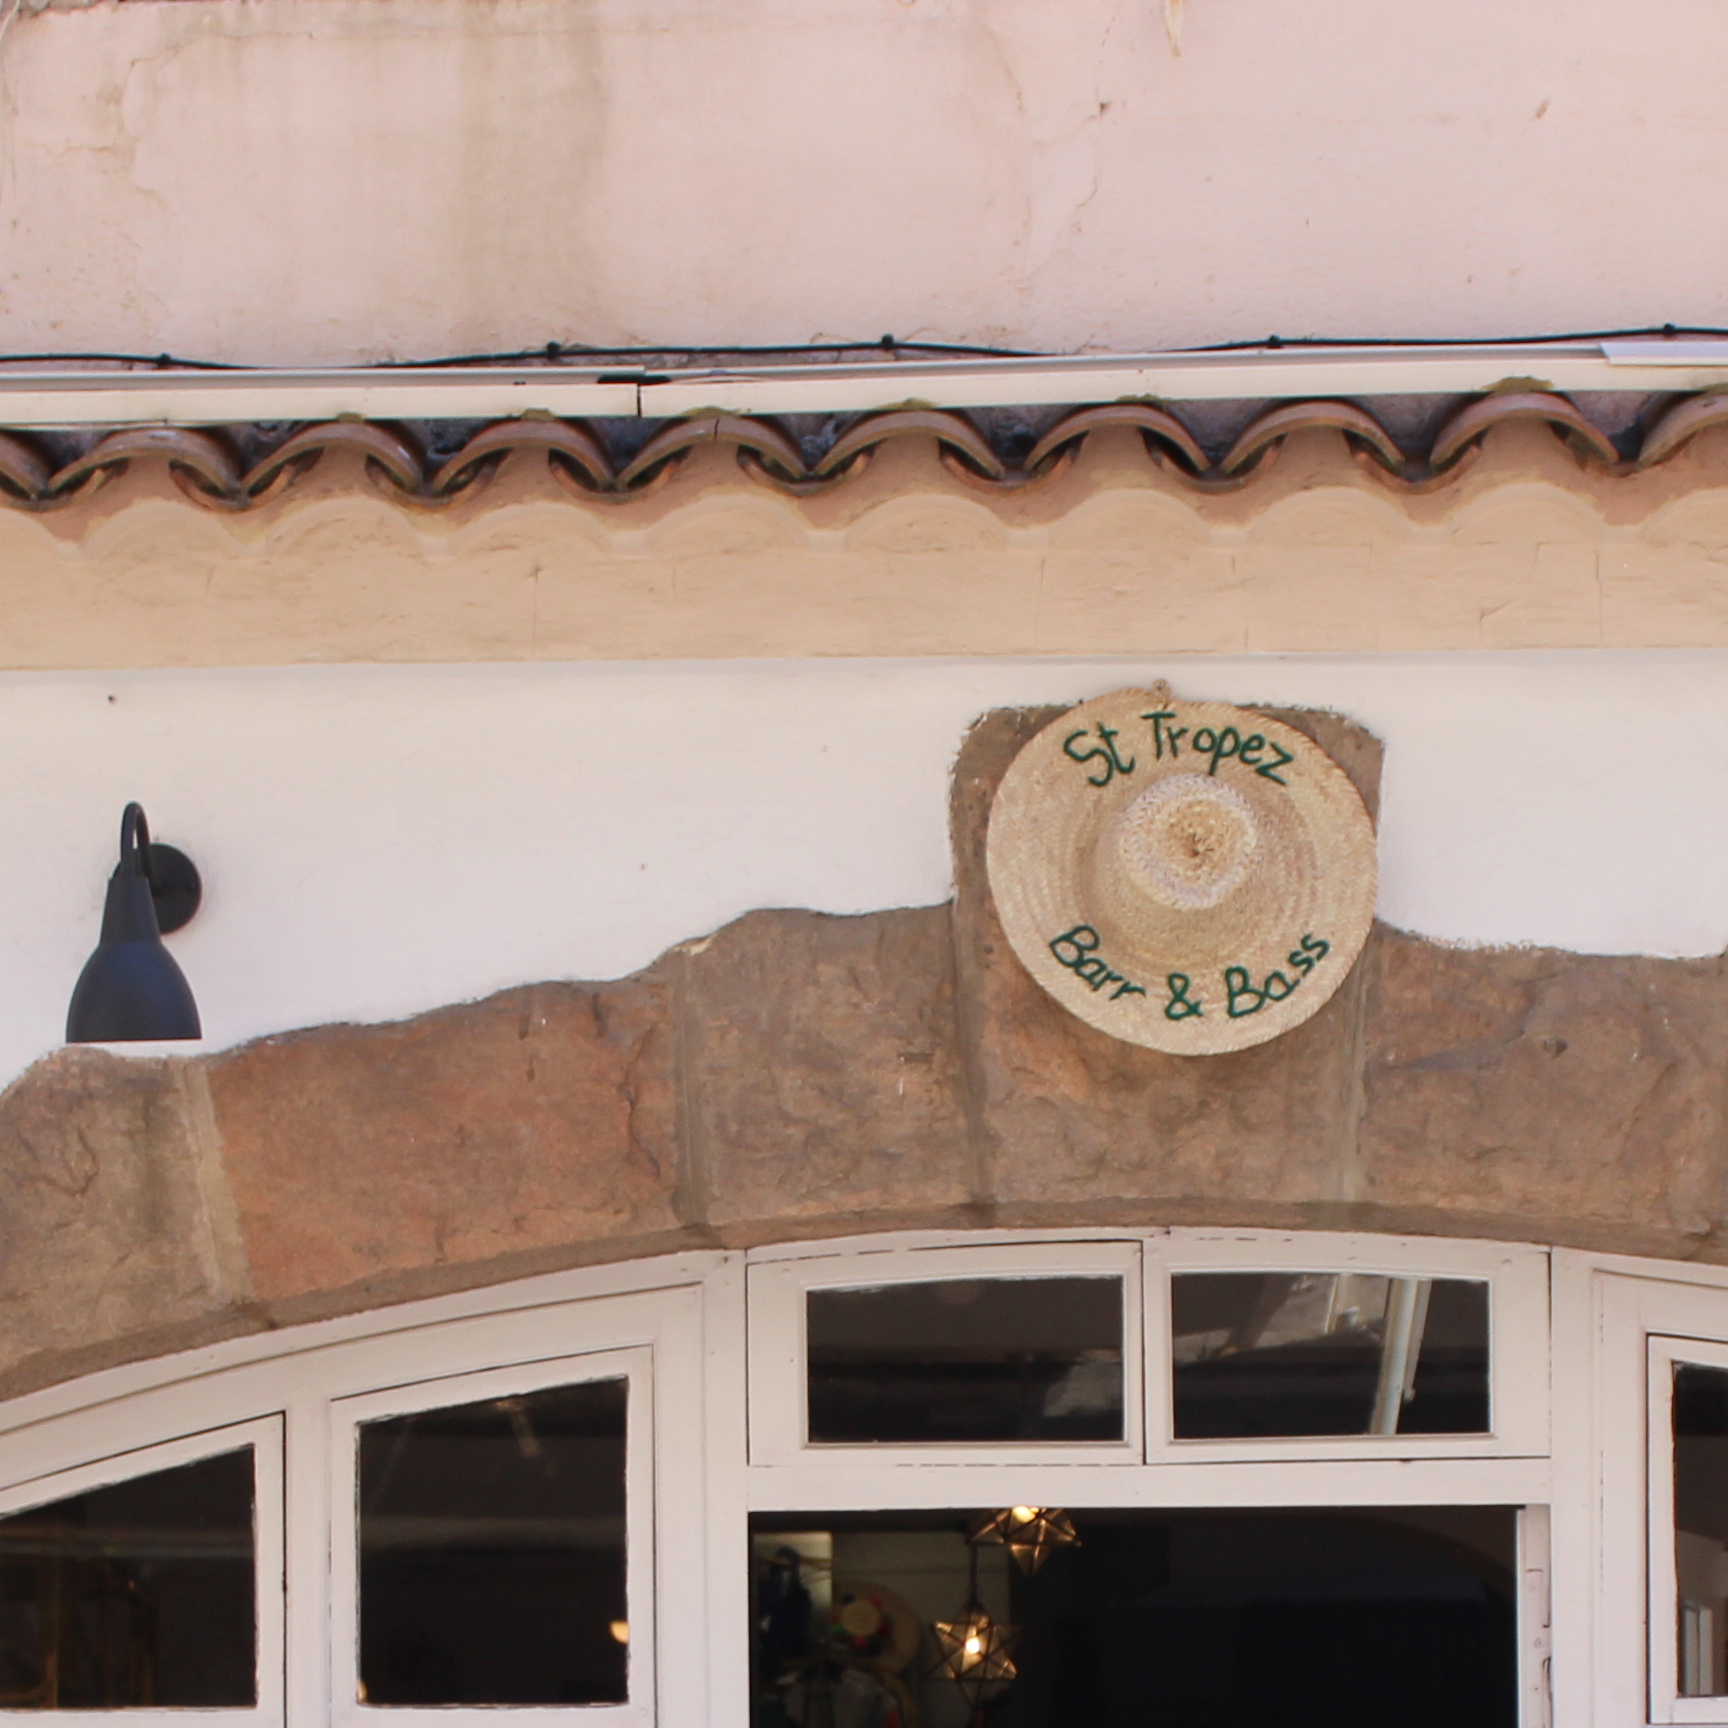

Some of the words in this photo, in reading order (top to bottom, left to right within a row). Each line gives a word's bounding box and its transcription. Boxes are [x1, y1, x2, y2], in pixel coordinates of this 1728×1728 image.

[1063, 722, 1136, 787] St
[1140, 711, 1295, 787] Tropez
[1165, 972, 1205, 1021] &
[1225, 933, 1331, 1019] Bass
